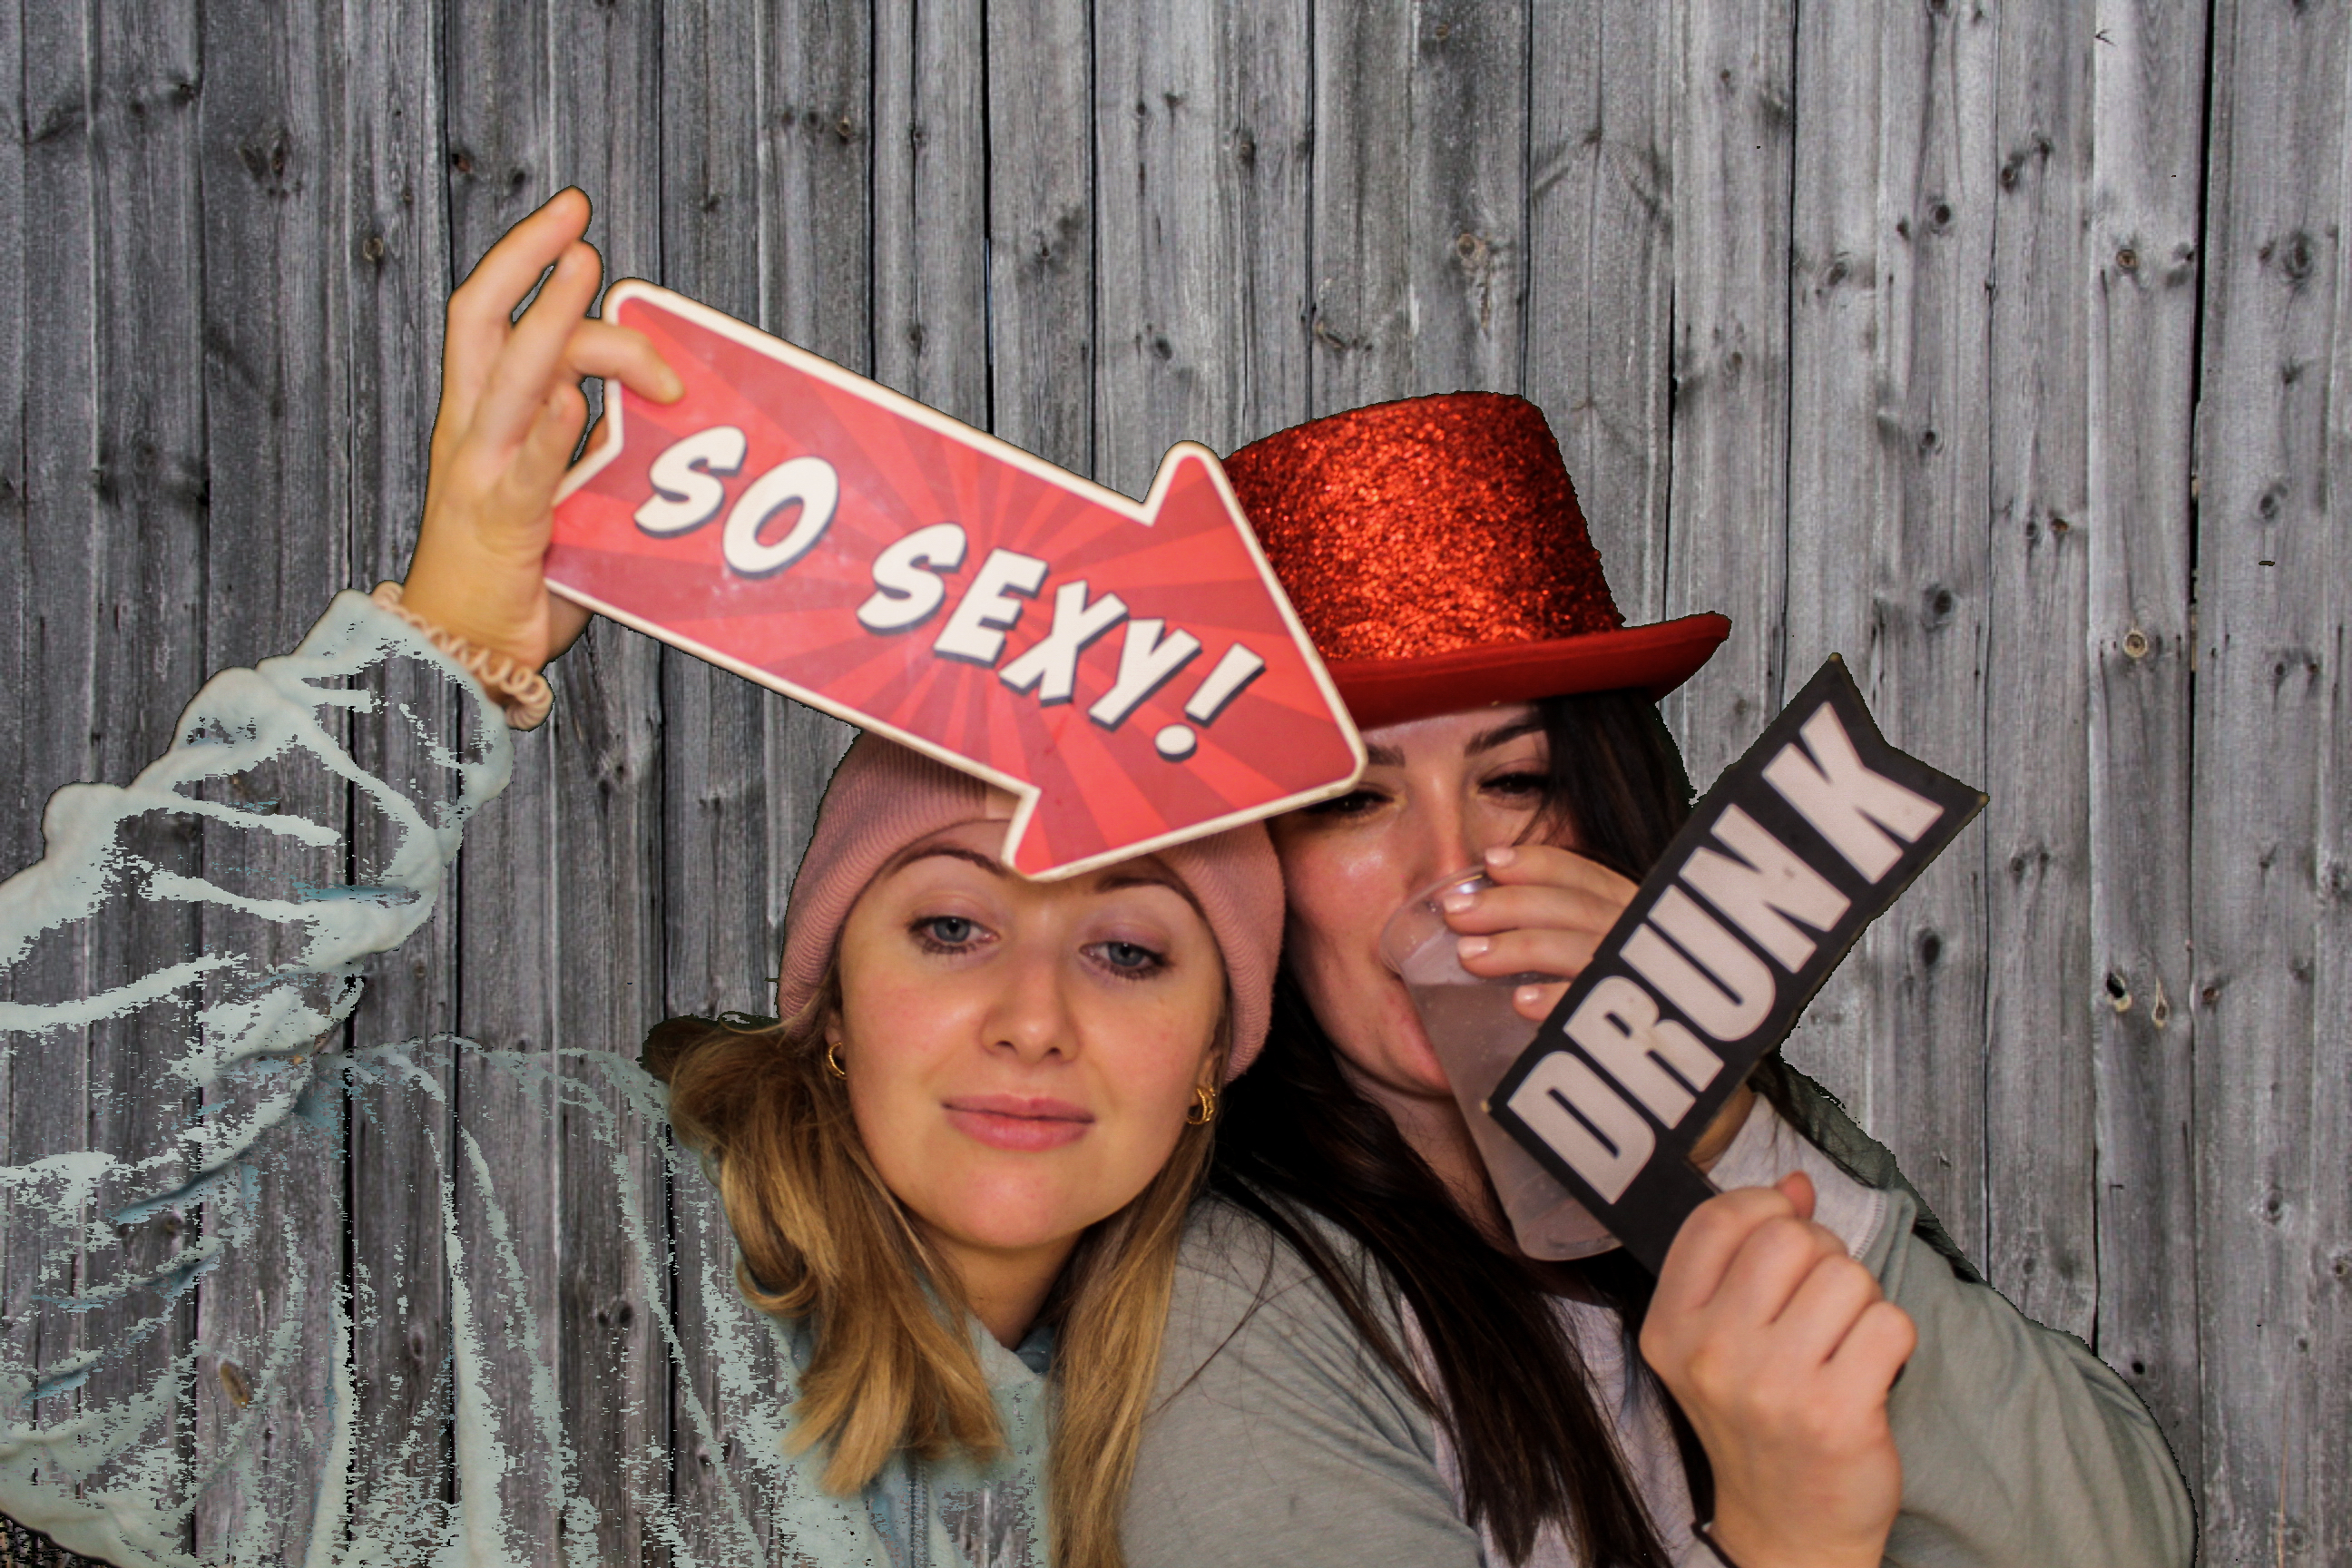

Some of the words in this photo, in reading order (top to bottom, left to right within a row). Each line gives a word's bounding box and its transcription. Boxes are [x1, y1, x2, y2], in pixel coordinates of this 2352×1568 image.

[633, 425, 840, 580] SO
[856, 522, 1265, 762] SEXY!
[1506, 701, 1945, 1205] DRUNK
